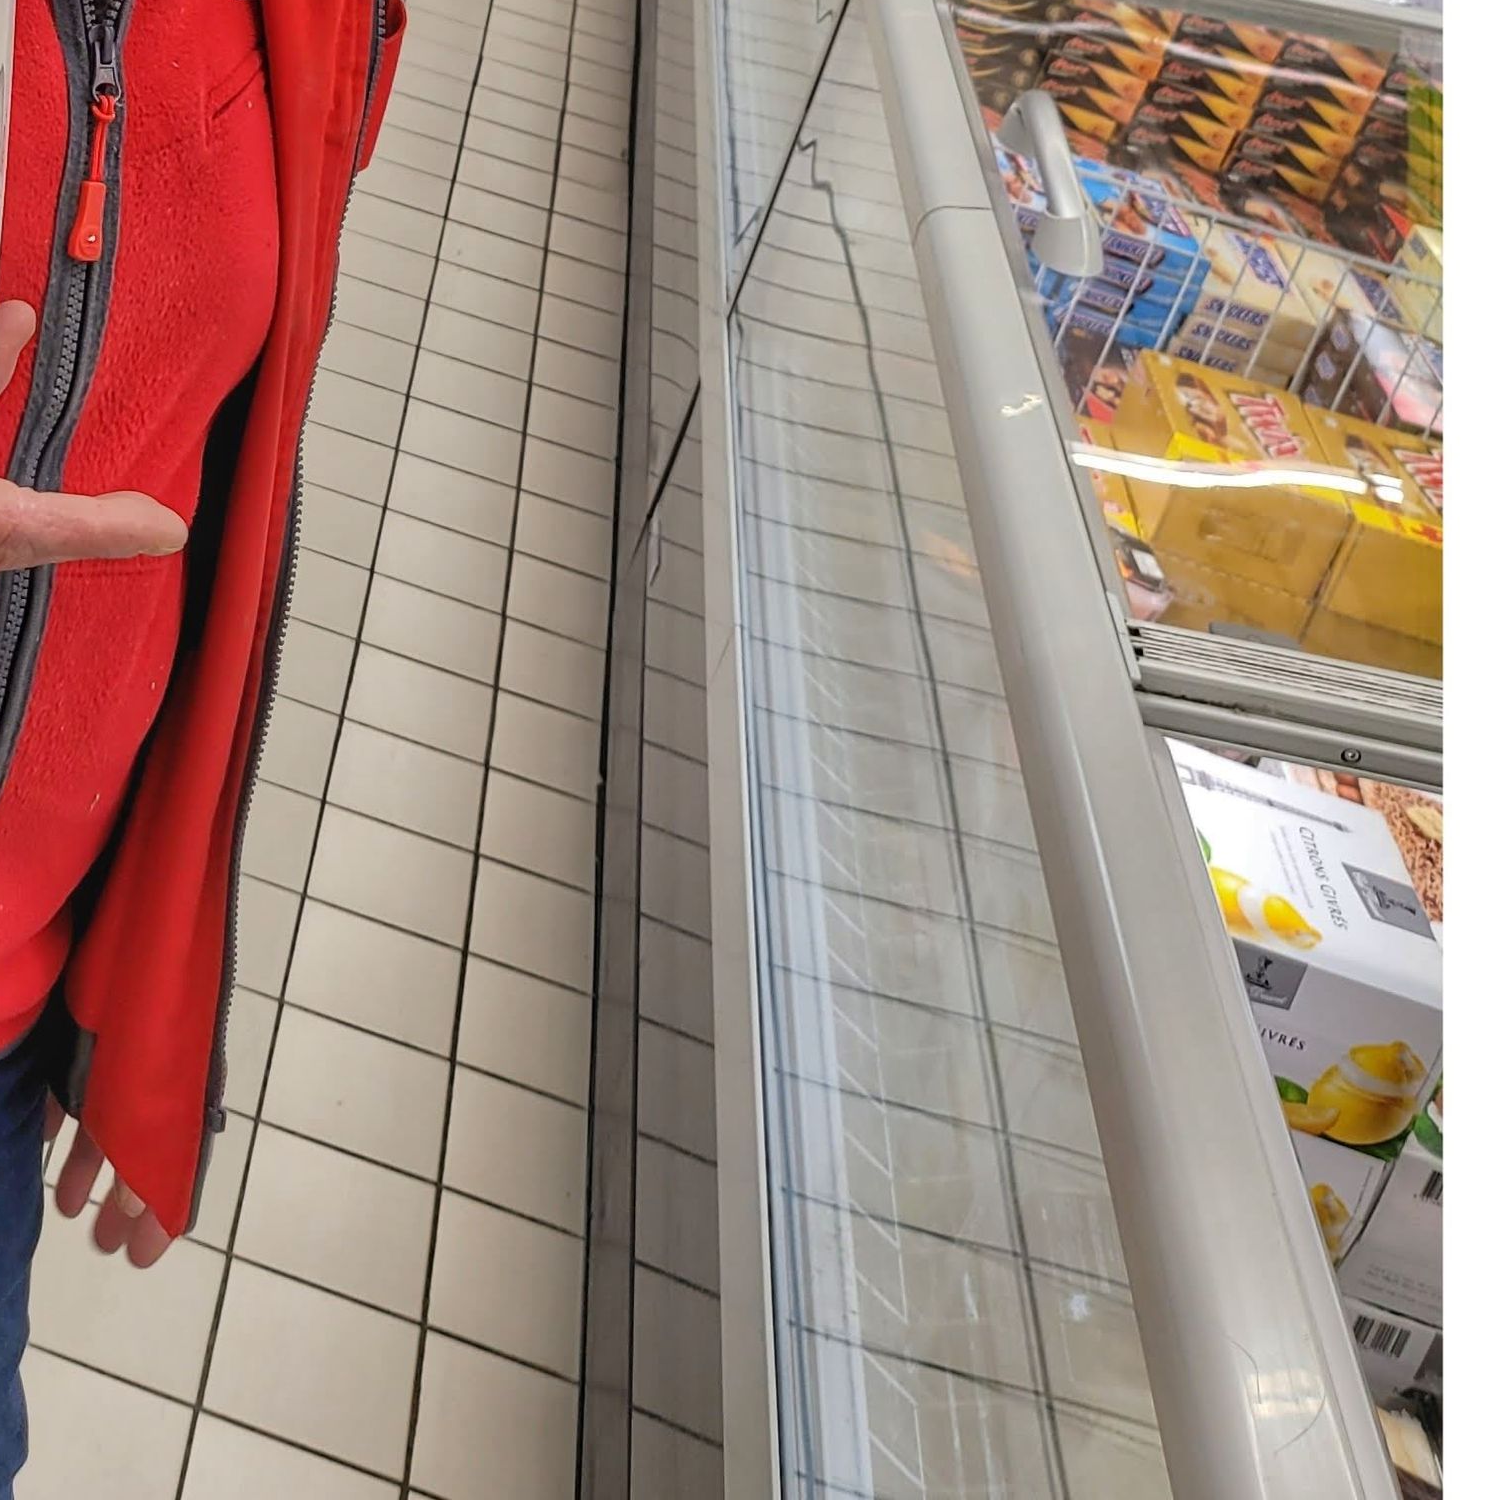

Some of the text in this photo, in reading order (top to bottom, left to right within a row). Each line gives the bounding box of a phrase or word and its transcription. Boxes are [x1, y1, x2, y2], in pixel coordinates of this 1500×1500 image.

[1205, 298, 1270, 328] SNCKERS
[1192, 323, 1252, 350] SNCKERS
[1299, 825, 1330, 883] CITRONS
[1260, 1027, 1307, 1051] IVRÉS
